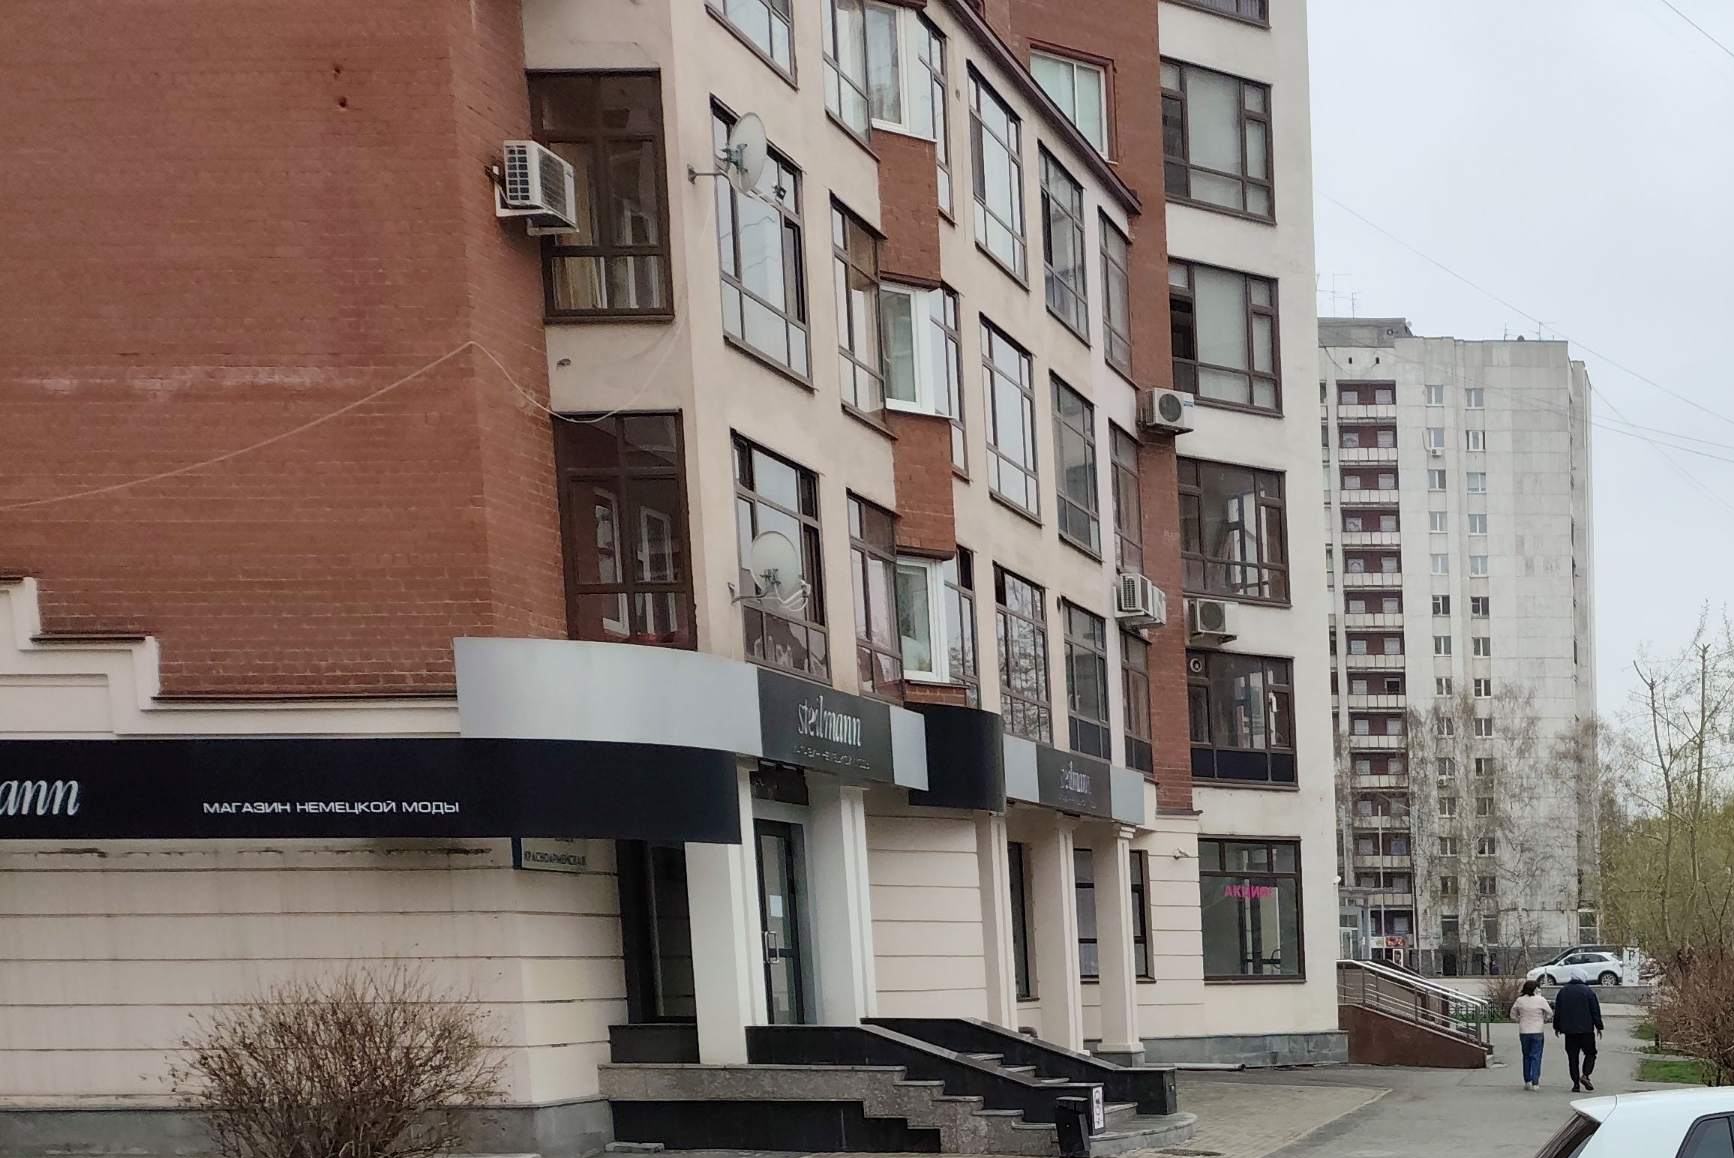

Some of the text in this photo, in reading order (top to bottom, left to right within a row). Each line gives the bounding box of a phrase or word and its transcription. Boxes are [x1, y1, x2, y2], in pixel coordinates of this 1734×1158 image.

[203, 800, 460, 815] МАГАЗИН НЕМЕЦКОЙ МОДЫ
